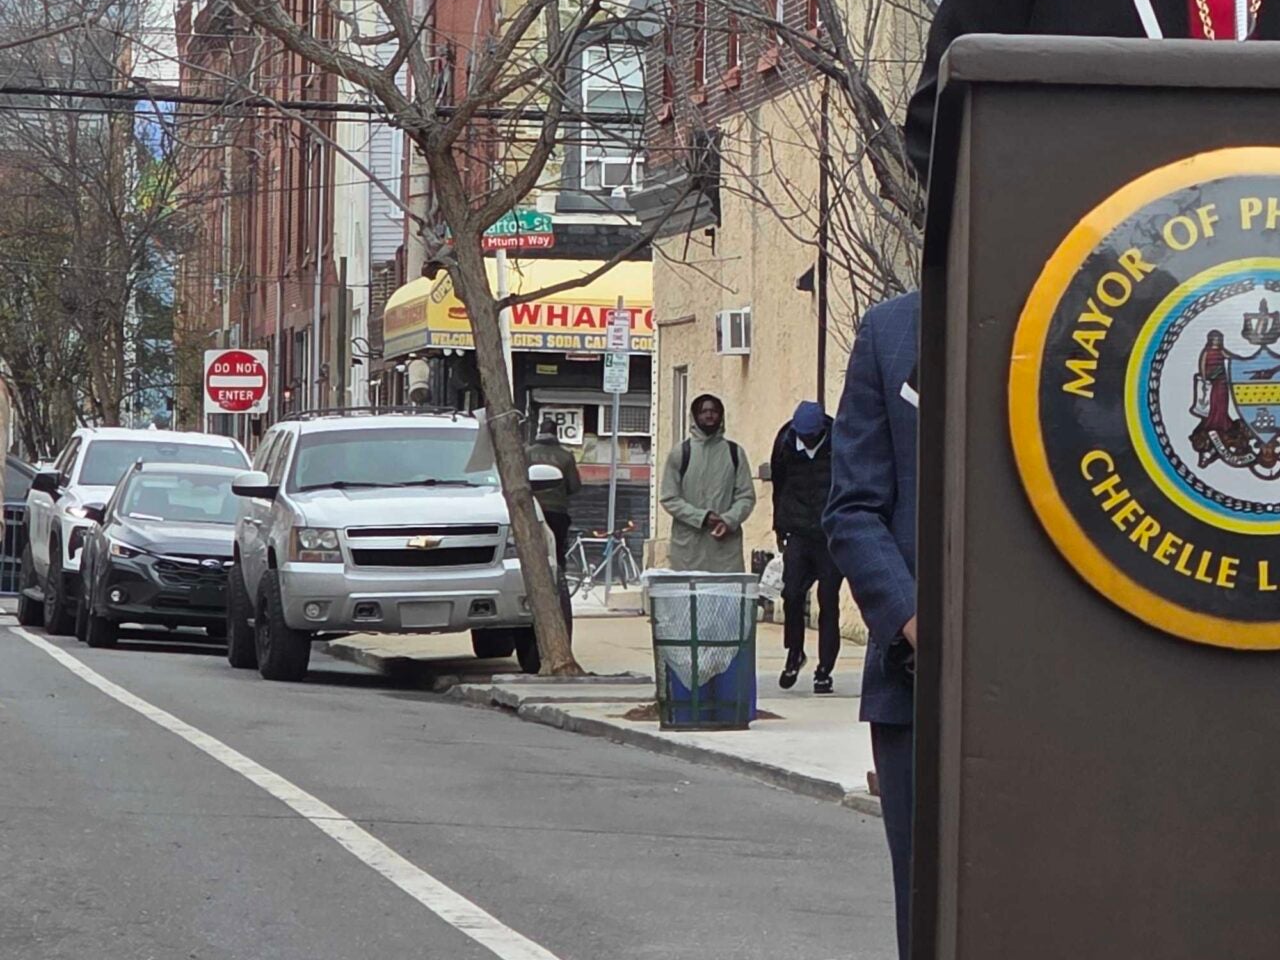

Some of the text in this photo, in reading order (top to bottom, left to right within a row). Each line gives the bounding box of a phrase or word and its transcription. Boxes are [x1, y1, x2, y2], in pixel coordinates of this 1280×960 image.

[487, 217, 548, 233] arton St
[528, 235, 550, 246] Way
[1063, 247, 1157, 398] MAYOR
[1163, 204, 1219, 251] OF
[546, 334, 581, 348] SODA
[214, 363, 257, 373] DO NOT
[218, 390, 254, 400] ENTER
[559, 426, 577, 439] IC
[1080, 449, 1240, 589] CHERELLE
